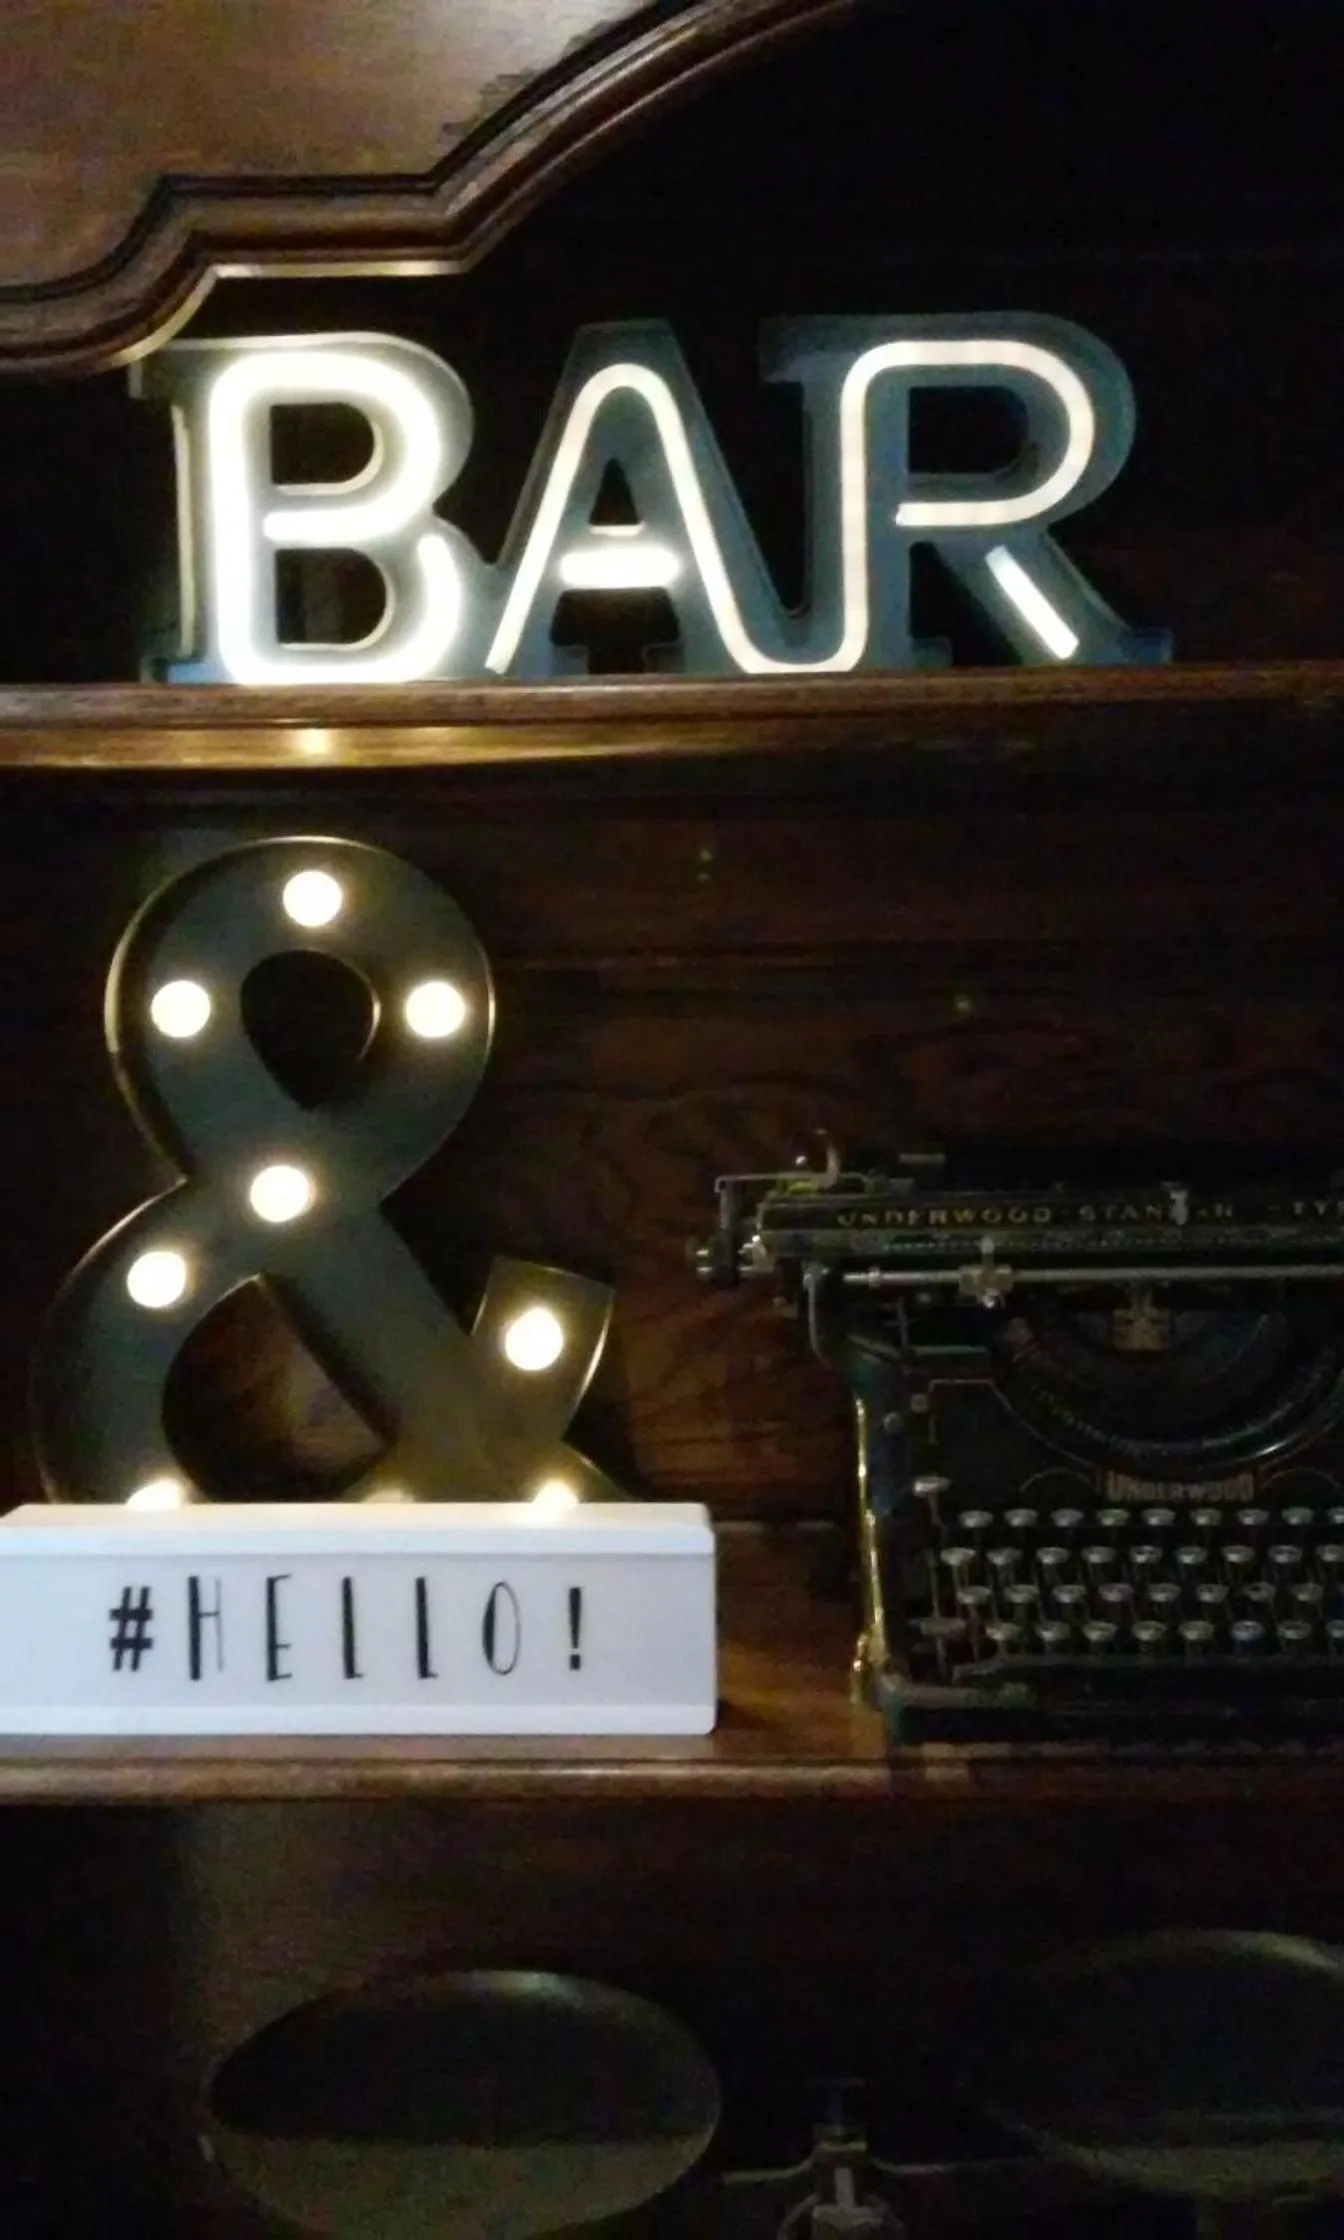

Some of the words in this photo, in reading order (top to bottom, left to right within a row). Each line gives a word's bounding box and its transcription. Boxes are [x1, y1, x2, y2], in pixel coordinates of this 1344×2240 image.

[134, 312, 1174, 686] BAR
[30, 833, 638, 1505] &
[109, 1574, 583, 1681] #HELLO!
